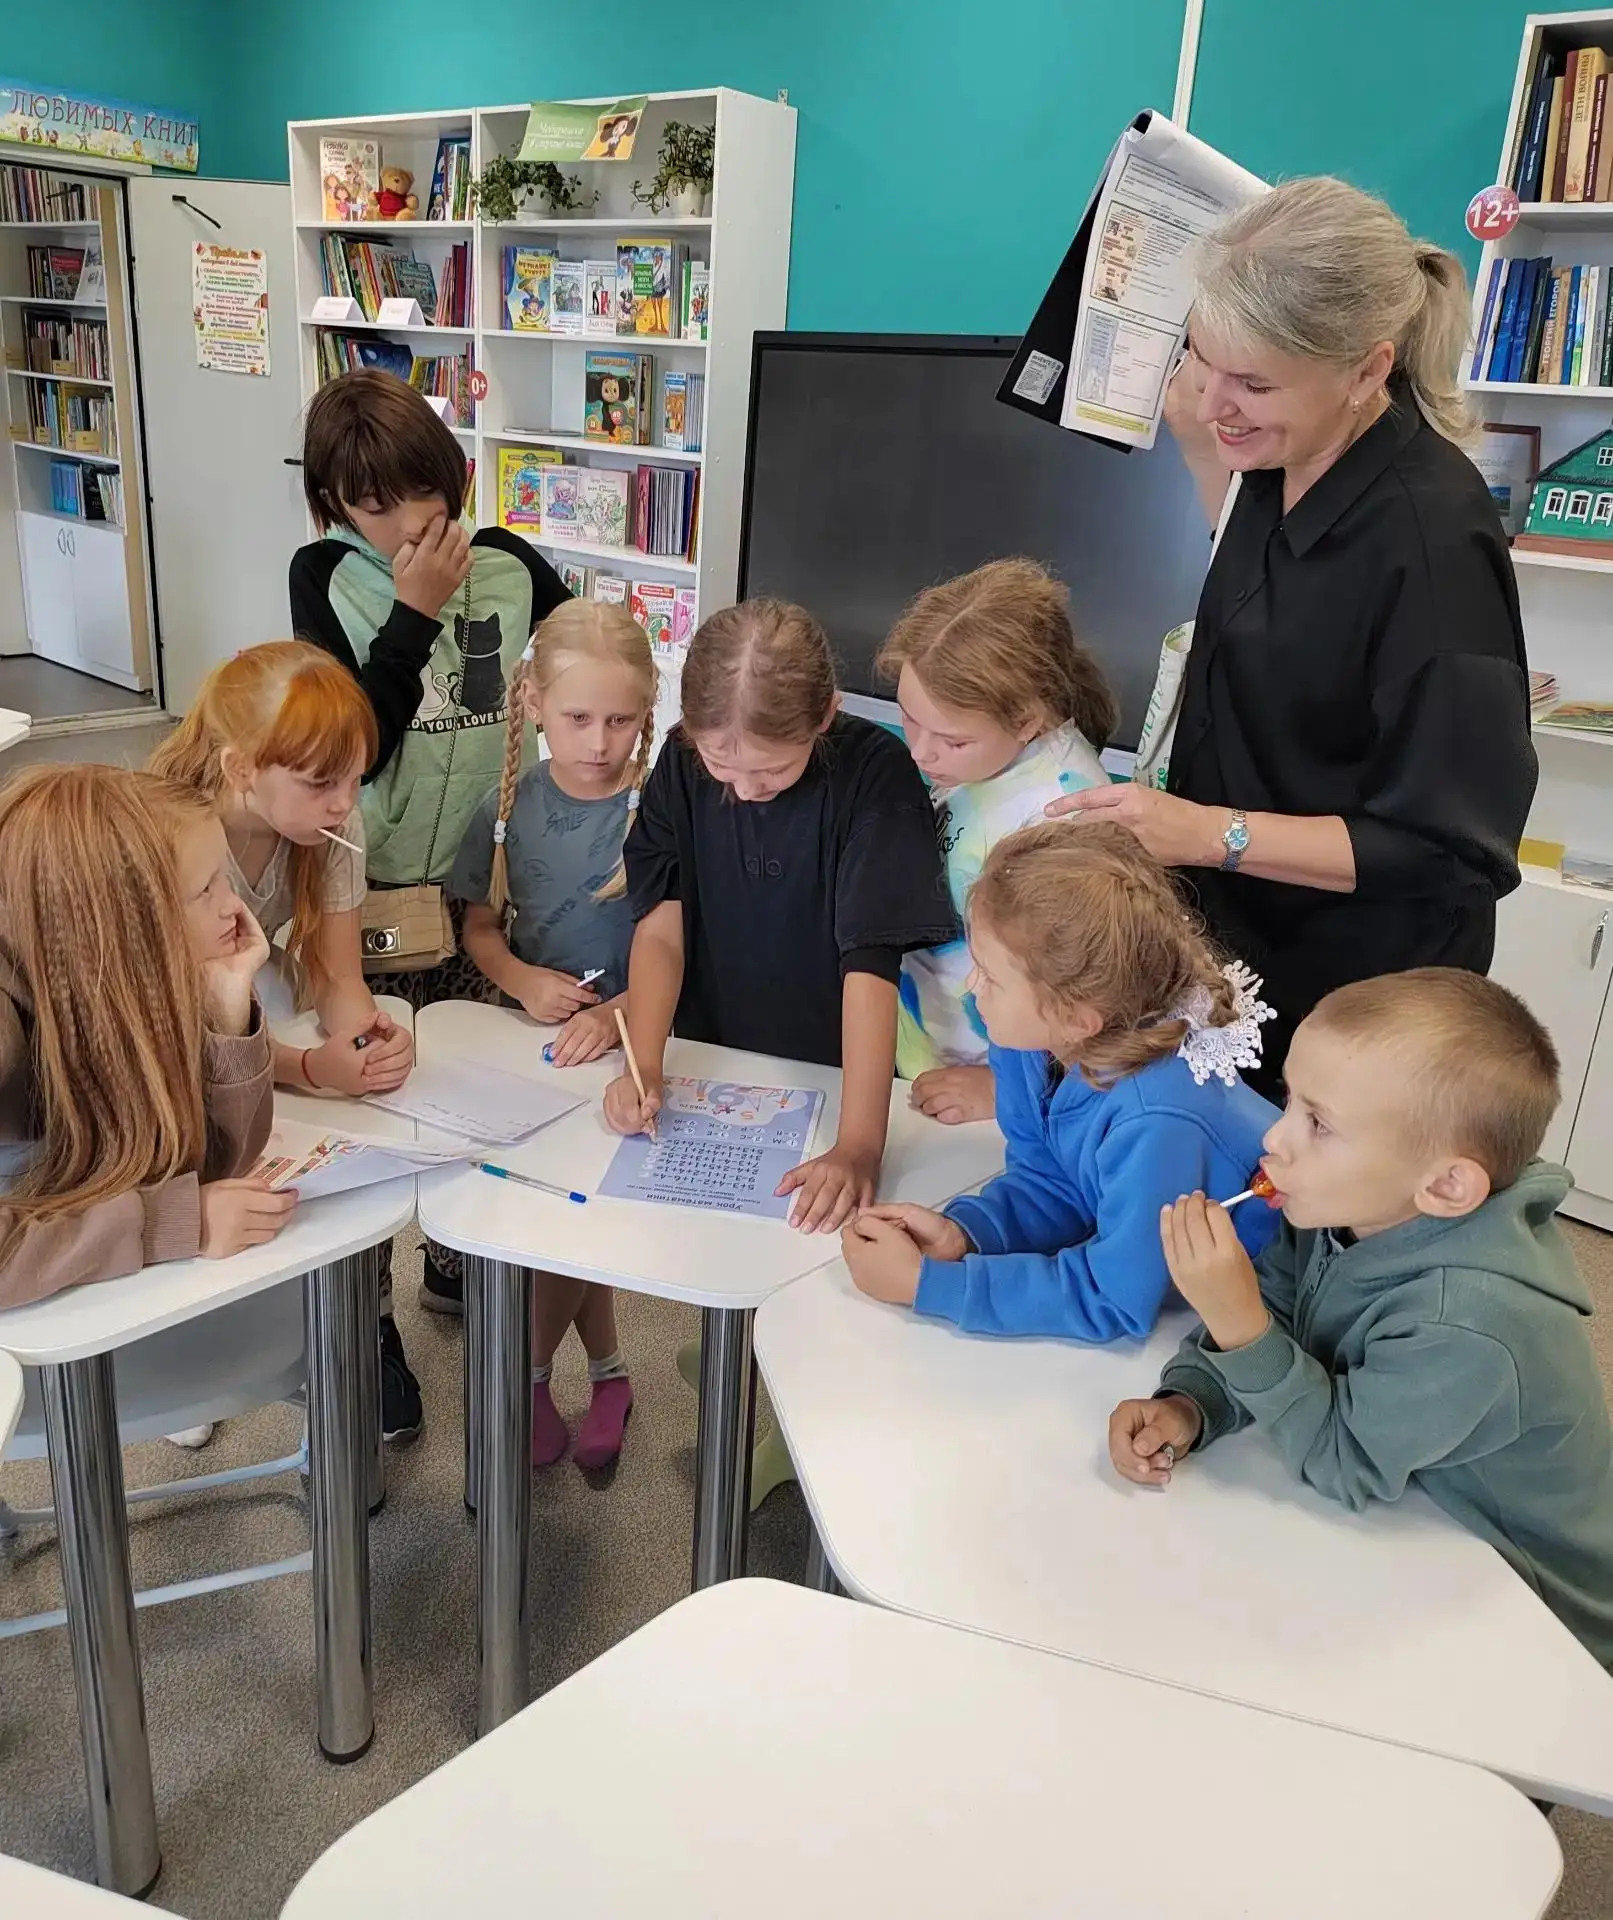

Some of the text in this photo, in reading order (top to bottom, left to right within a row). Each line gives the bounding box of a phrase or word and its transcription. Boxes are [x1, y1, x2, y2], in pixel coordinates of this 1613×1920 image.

[10, 90, 198, 145] ЛЮБИМЫХ КНИГ
[1469, 200, 1519, 228] 12+
[1541, 279, 1560, 365] ГЕОРГИЙ ЕГОРОВ
[472, 377, 487, 395] 0+
[464, 712, 495, 727] LOVE
[646, 1193, 714, 1206] математики
[716, 1202, 744, 1211] Урок
